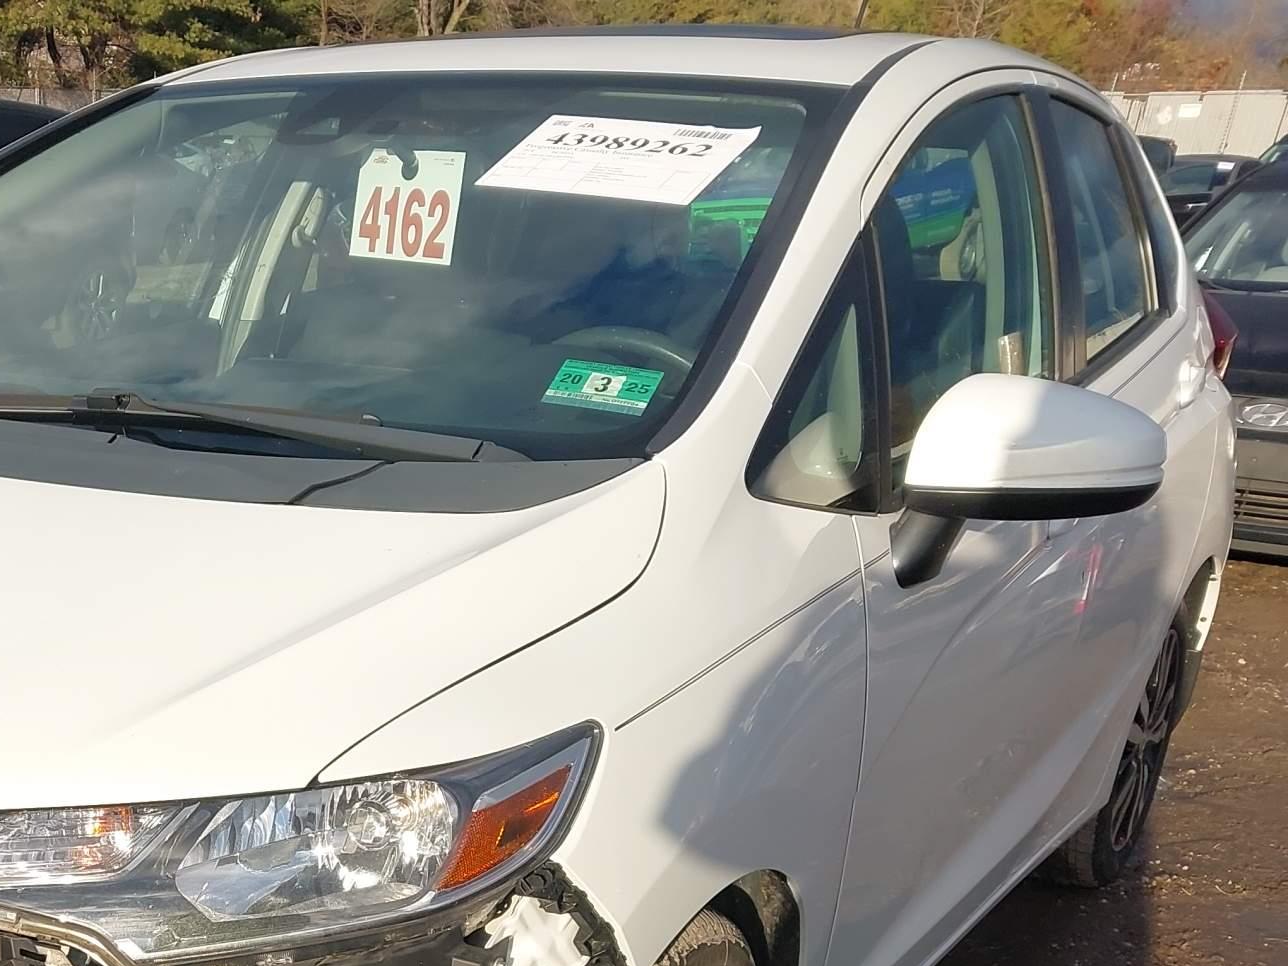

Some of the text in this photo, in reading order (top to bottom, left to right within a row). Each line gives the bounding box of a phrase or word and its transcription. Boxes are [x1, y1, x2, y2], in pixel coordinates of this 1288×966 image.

[545, 131, 713, 157] 43989262
[358, 186, 451, 259] 4162
[559, 372, 651, 394] 20 3 25
